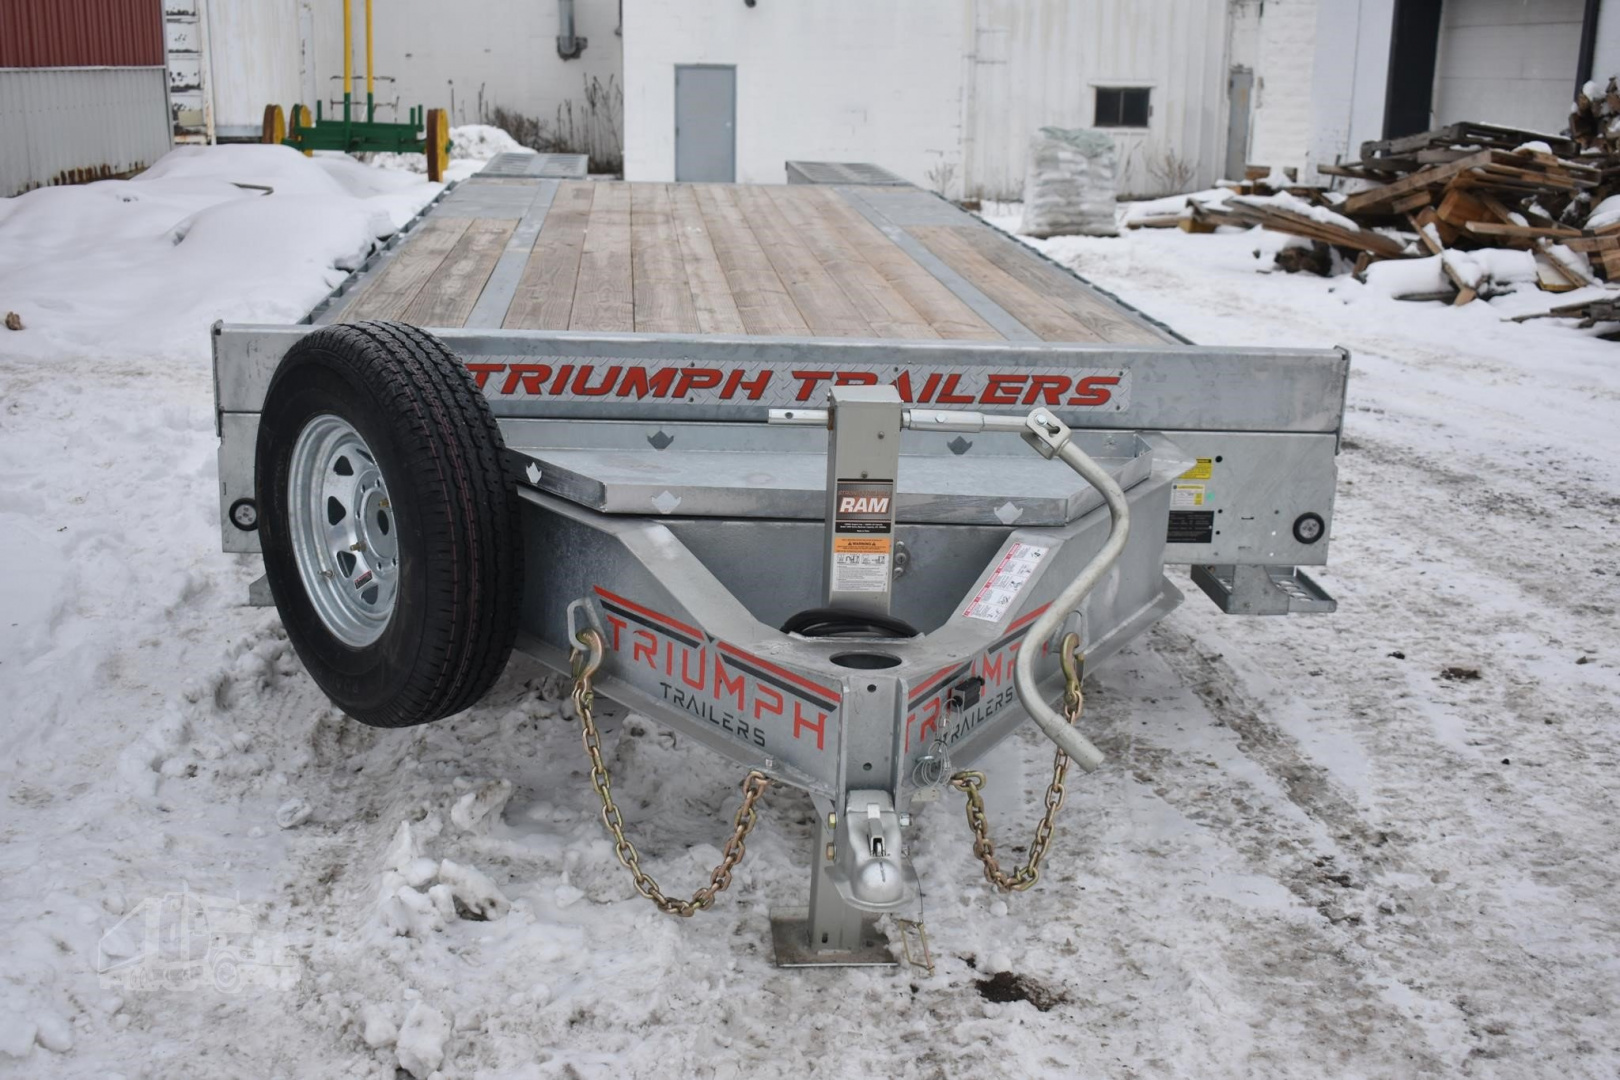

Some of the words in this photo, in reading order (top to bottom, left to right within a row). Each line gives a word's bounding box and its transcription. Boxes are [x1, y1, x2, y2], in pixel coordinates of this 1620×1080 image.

[465, 363, 773, 401] TRIUMPH
[839, 496, 890, 513] RAM
[606, 614, 828, 750] TRIUMPH
[660, 681, 766, 747] TRAILERS
[904, 639, 1048, 754] TRIM
